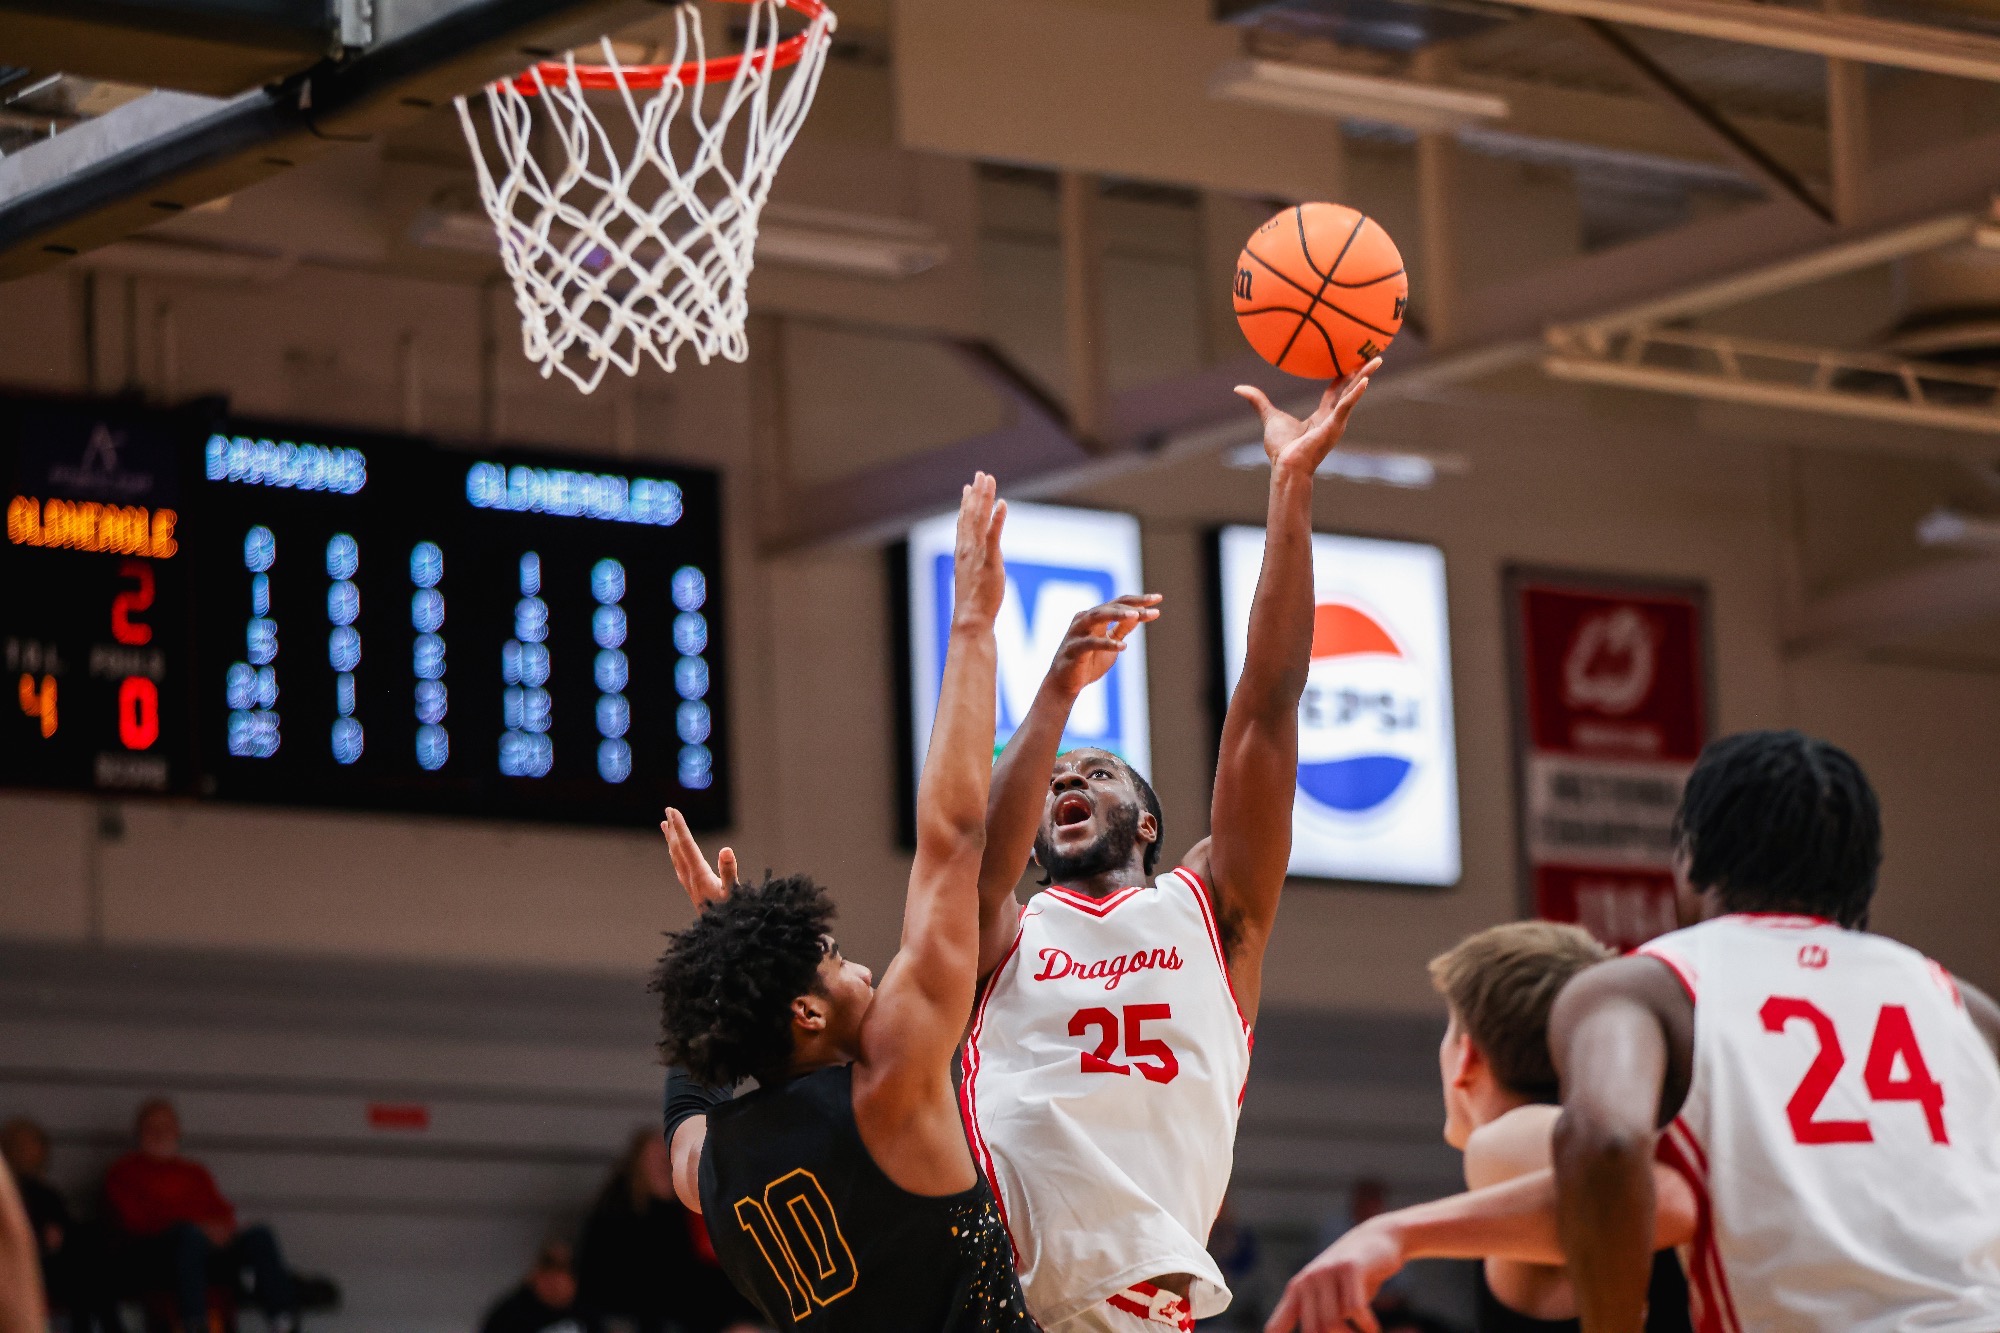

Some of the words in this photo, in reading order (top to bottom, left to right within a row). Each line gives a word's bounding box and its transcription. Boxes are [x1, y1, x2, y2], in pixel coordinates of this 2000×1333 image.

[112, 563, 155, 645] 2
[19, 674, 58, 738] 4
[119, 676, 159, 750] 0
[1299, 687, 1420, 733] EPSI
[1034, 946, 1183, 990] Dragons
[1068, 1003, 1179, 1084] 25
[1759, 994, 1951, 1146] 24
[734, 1167, 858, 1322] 10
